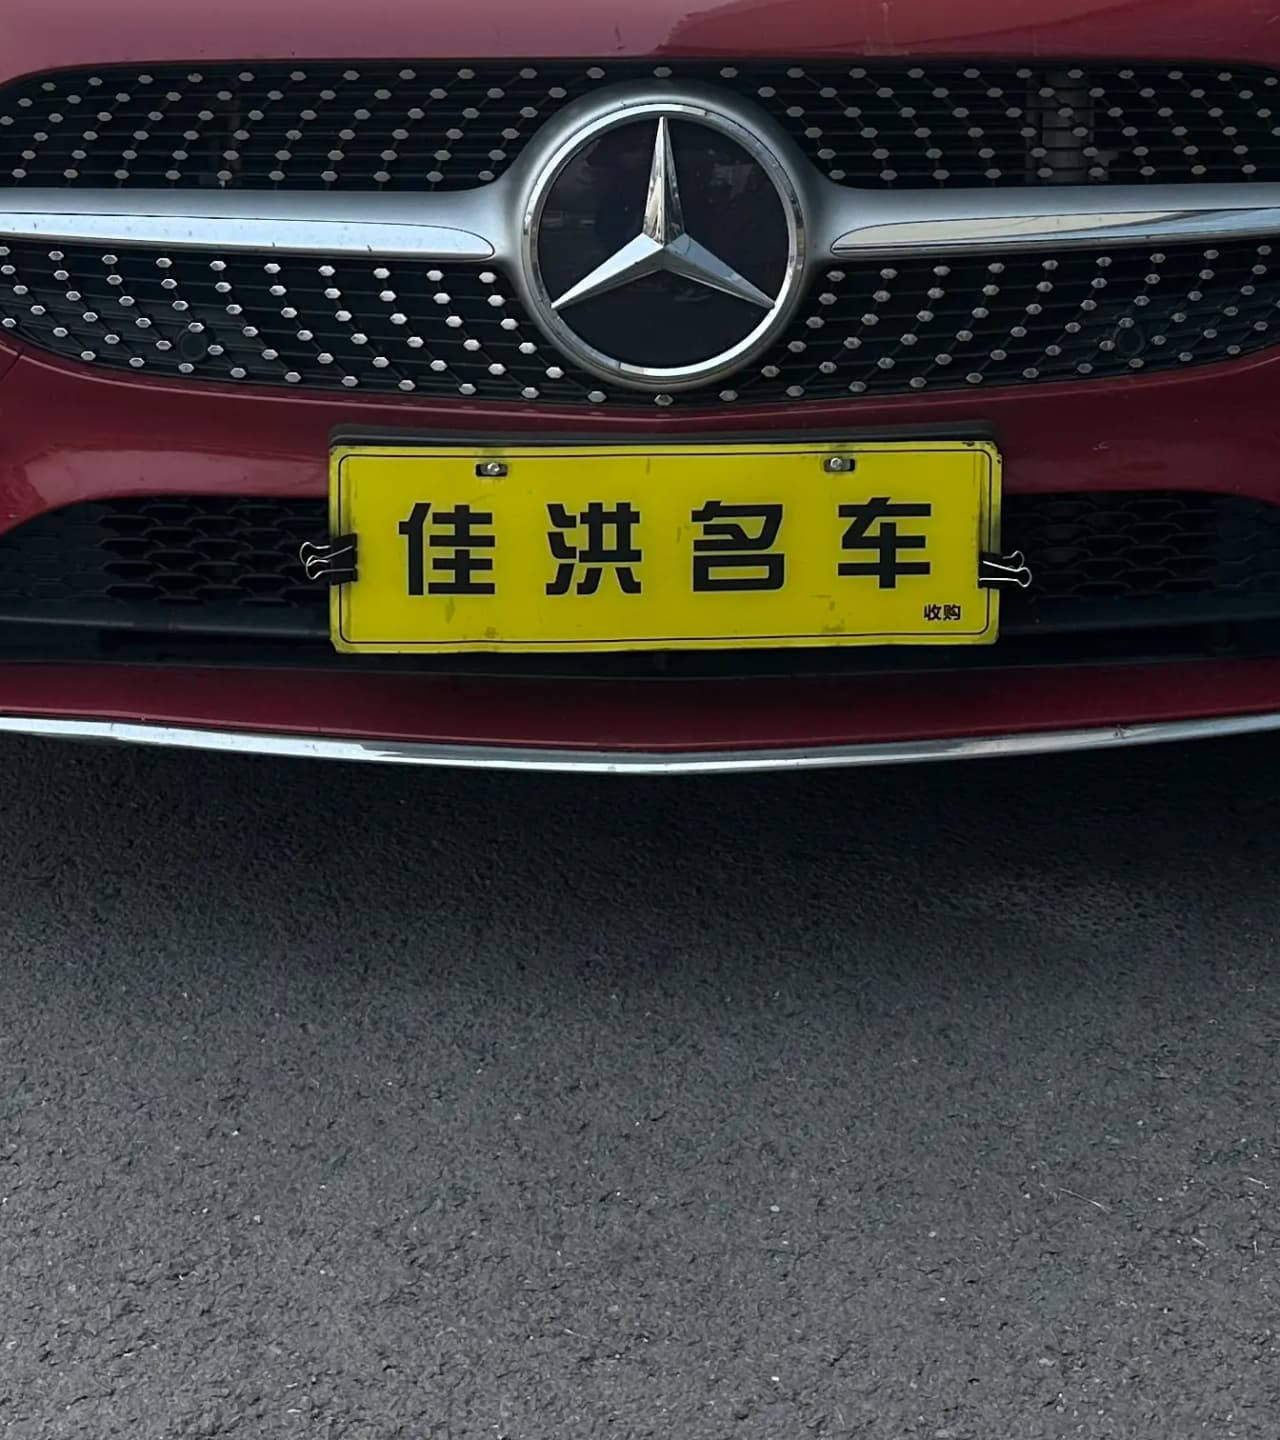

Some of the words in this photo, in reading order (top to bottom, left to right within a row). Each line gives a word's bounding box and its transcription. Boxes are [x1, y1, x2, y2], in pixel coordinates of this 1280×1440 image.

[398, 496, 933, 597] 佳洪名车
[923, 603, 961, 621] 收购
